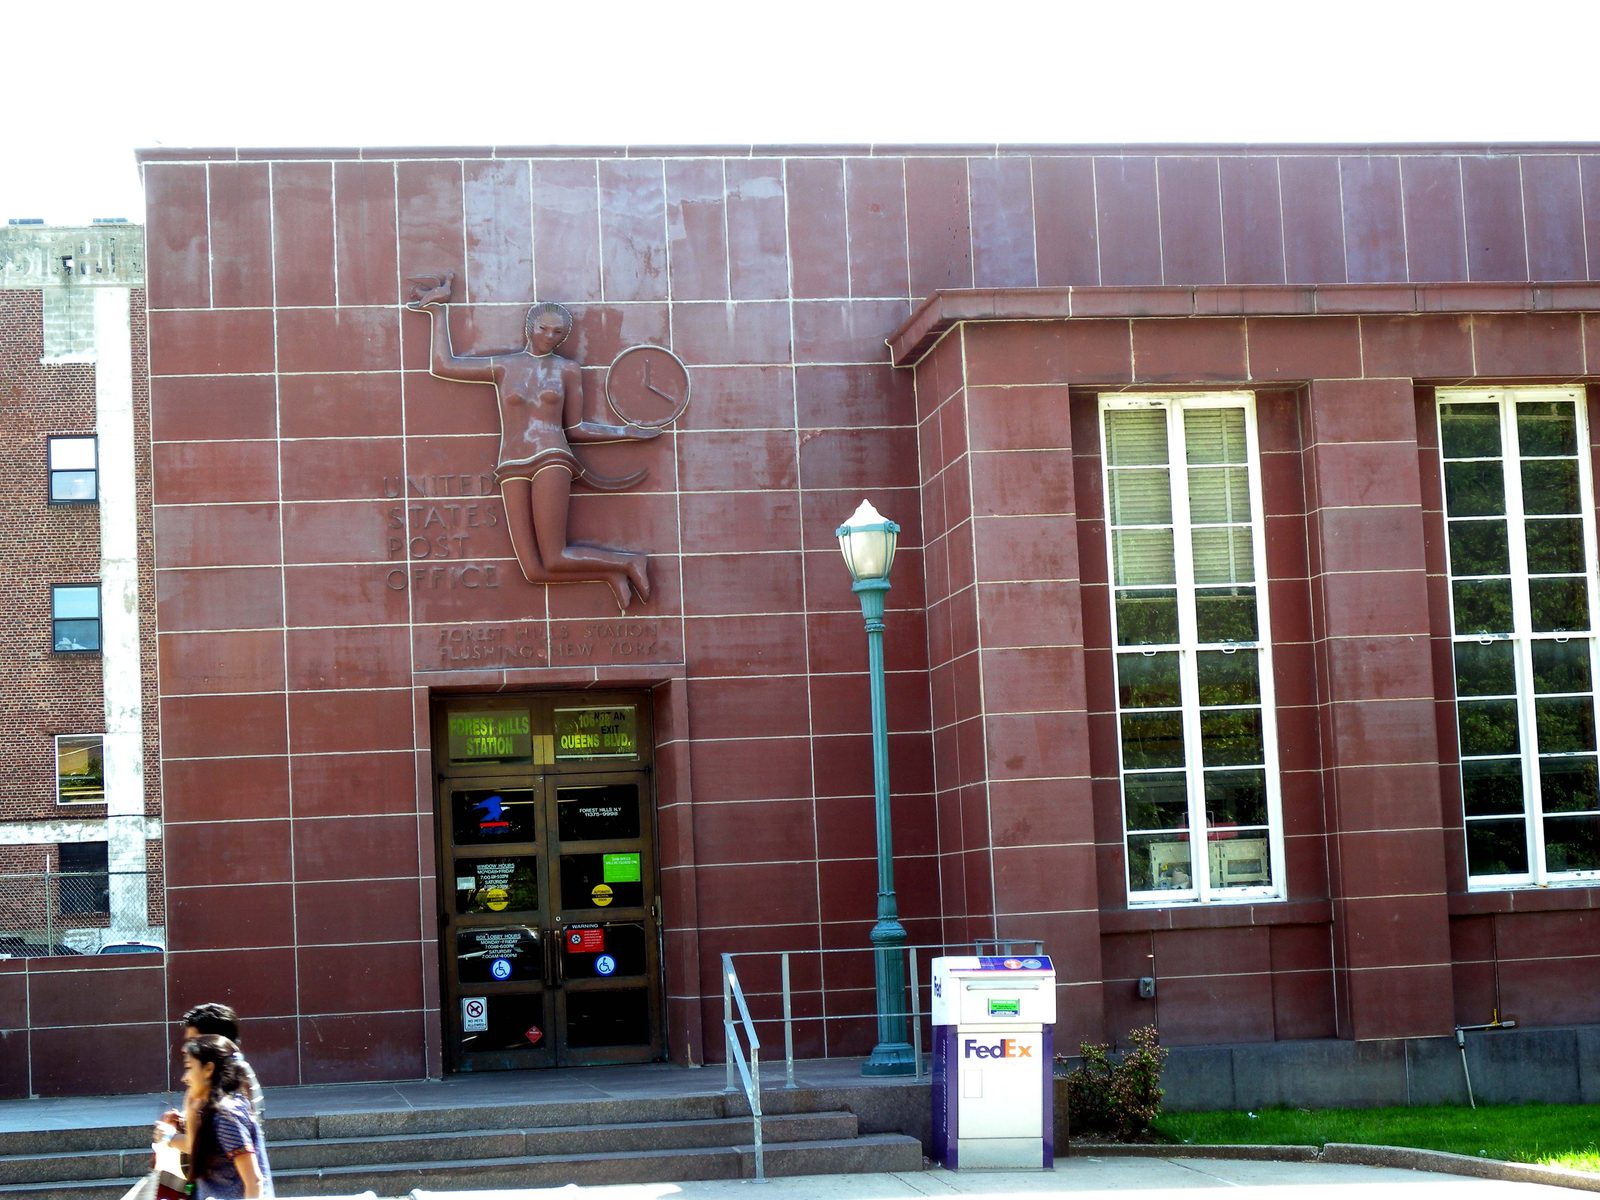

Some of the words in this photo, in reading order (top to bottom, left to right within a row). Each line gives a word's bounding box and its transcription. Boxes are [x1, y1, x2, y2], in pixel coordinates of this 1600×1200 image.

[383, 474, 494, 498] UNITED
[388, 505, 497, 529] STATES
[388, 534, 470, 560] POST
[386, 566, 499, 590] OFFICE
[440, 628, 506, 643] FOREST
[516, 625, 568, 640] HILLS
[584, 623, 657, 640] STATION
[550, 643, 593, 658] NEW
[608, 641, 657, 656] YORK
[614, 711, 625, 721] AN
[450, 718, 493, 737] FOREST
[498, 716, 529, 735] HILLS
[601, 725, 619, 734] EXIT
[467, 737, 513, 756] STATION
[560, 733, 600, 749] QUEENS
[604, 732, 632, 748] BLVD.
[964, 1038, 1033, 1060] FedEx
